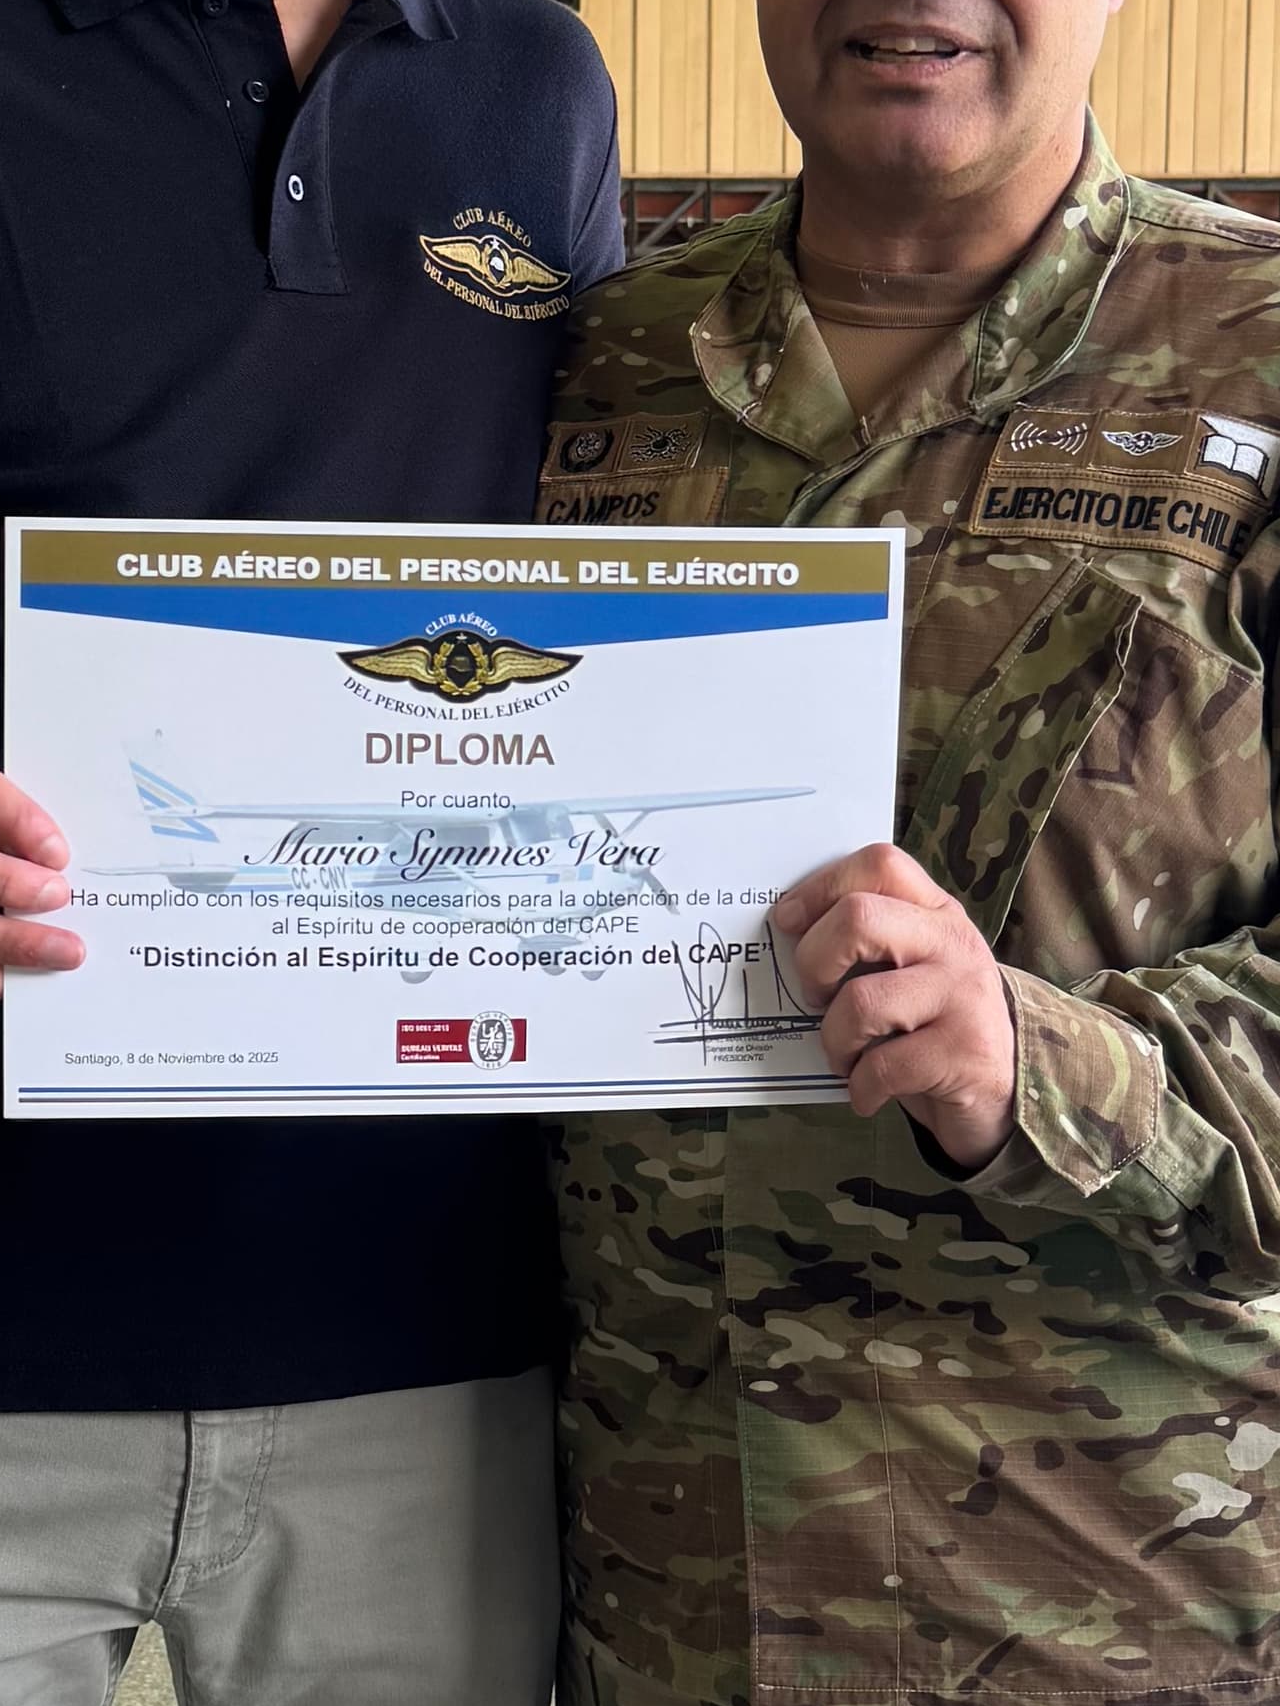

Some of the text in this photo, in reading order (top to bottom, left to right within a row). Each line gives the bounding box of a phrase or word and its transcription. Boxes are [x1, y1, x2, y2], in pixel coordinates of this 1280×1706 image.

[453, 207, 531, 247] CLUB AÉREO
[423, 259, 444, 285] DEL
[446, 277, 503, 315] PERSONAL
[504, 303, 523, 319] DEL
[547, 492, 660, 524] CAMPOS
[983, 487, 1251, 559] EJERCITO DE CHILE
[117, 550, 799, 586] CLUB AÉREO DEL PERSONAL DEL EJÉRCITO
[425, 612, 497, 637] CLUB AÉREO
[343, 676, 570, 721] DEL PERSONAL DEL EJÉRCITO
[365, 732, 555, 766] DIPLOMA
[401, 790, 516, 811] Por cuanto,
[243, 827, 666, 882] Mario Symmes Vera
[70, 890, 98, 907] Ha
[106, 890, 199, 911] cumplido
[206, 894, 242, 907] con
[250, 889, 279, 907] los
[286, 889, 384, 912] requisitos
[391, 890, 500, 907] necesarios
[508, 894, 551, 911] para
[559, 889, 576, 907] la
[583, 889, 678, 907] obtención
[686, 888, 709, 906] de
[717, 887, 733, 906] la
[272, 916, 640, 938] al Espíritu de cooperación del CAPE
[287, 946, 309, 967] al
[318, 946, 419, 971] Espíritu
[429, 946, 459, 967] de
[468, 945, 632, 971] Cooperación
[642, 944, 679, 964] del
[65, 1051, 279, 1067] Santiago, 8 de Noviembre de 2025
